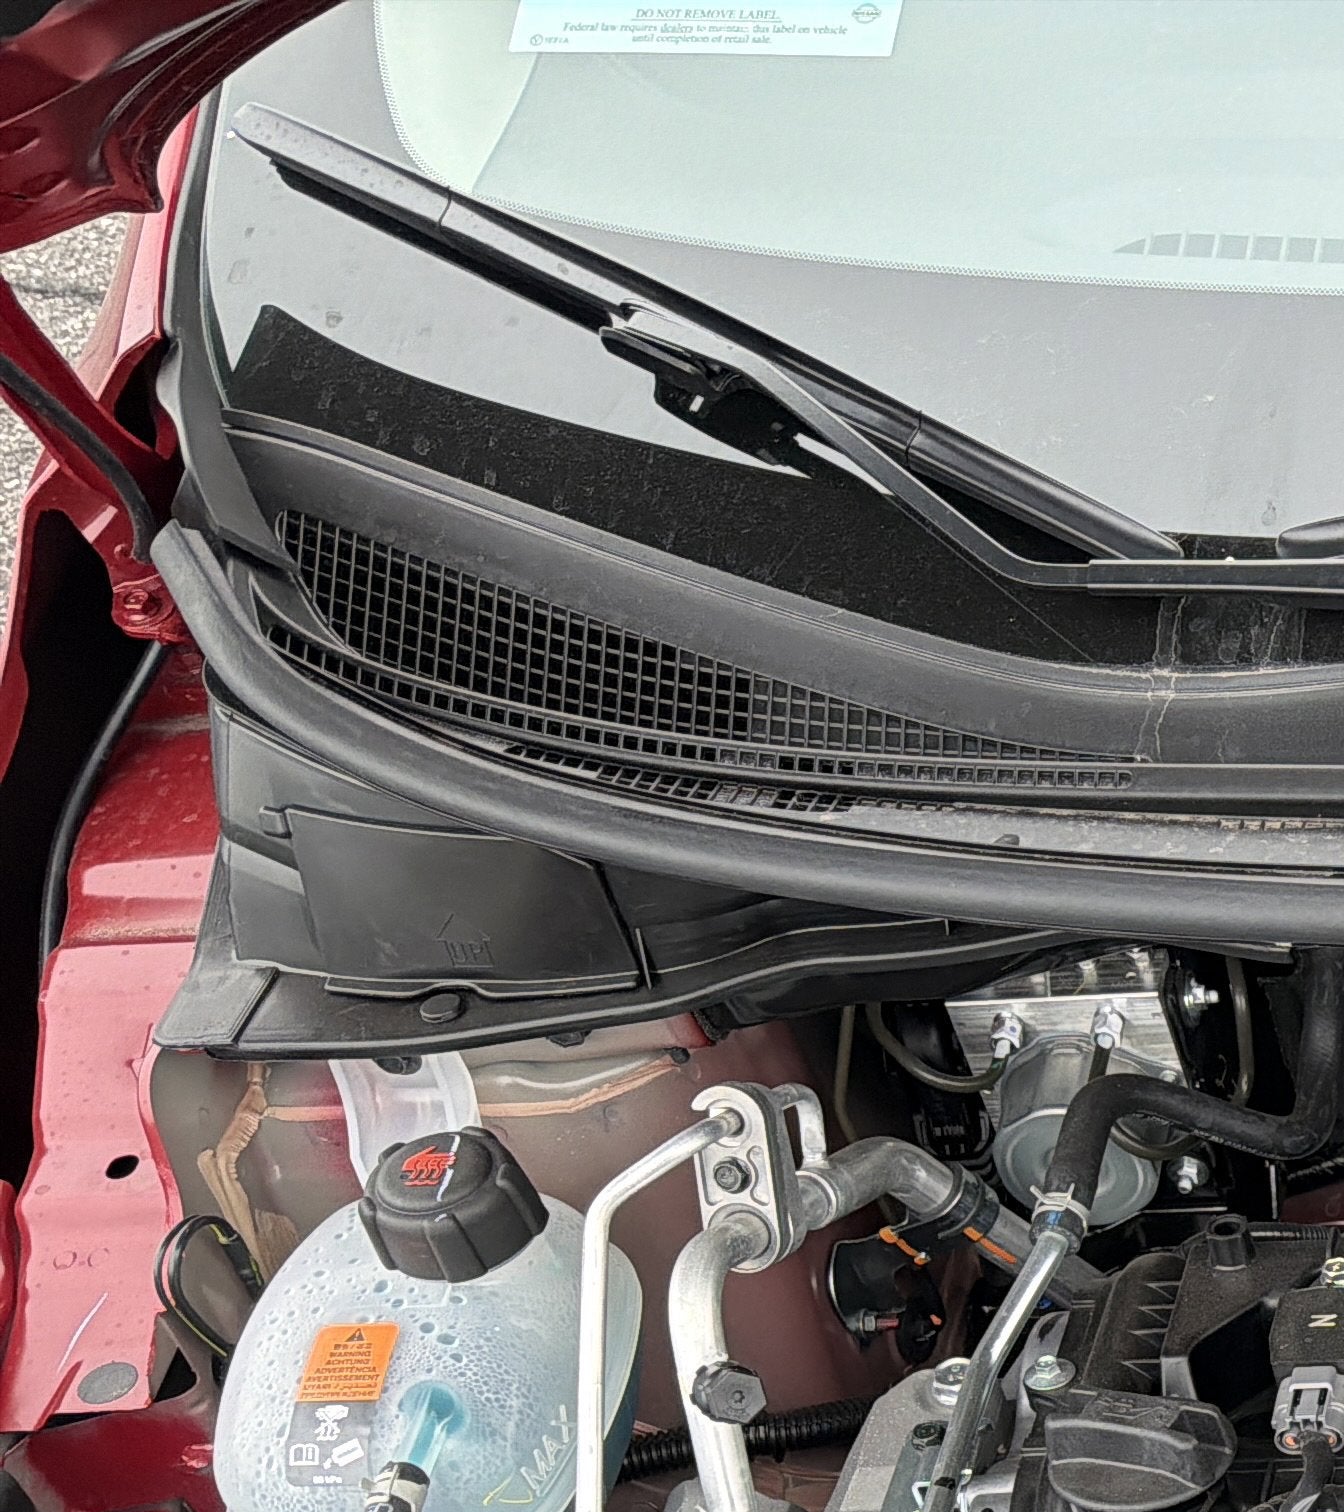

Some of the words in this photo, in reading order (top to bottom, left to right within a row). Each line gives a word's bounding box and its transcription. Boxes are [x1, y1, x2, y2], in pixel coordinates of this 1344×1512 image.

[636, 9, 654, 18] DO
[656, 9, 681, 18] NOT
[685, 9, 735, 19] REMOVE
[563, 22, 598, 31] Federal
[601, 23, 616, 31] law
[620, 24, 657, 34] requires
[772, 25, 795, 33] label
[814, 25, 848, 34] vehicle
[632, 34, 654, 42] until
[656, 34, 708, 45] completion
[725, 35, 749, 43] retail
[451, 941, 484, 963] UP
[520, 1404, 578, 1492] MAX
